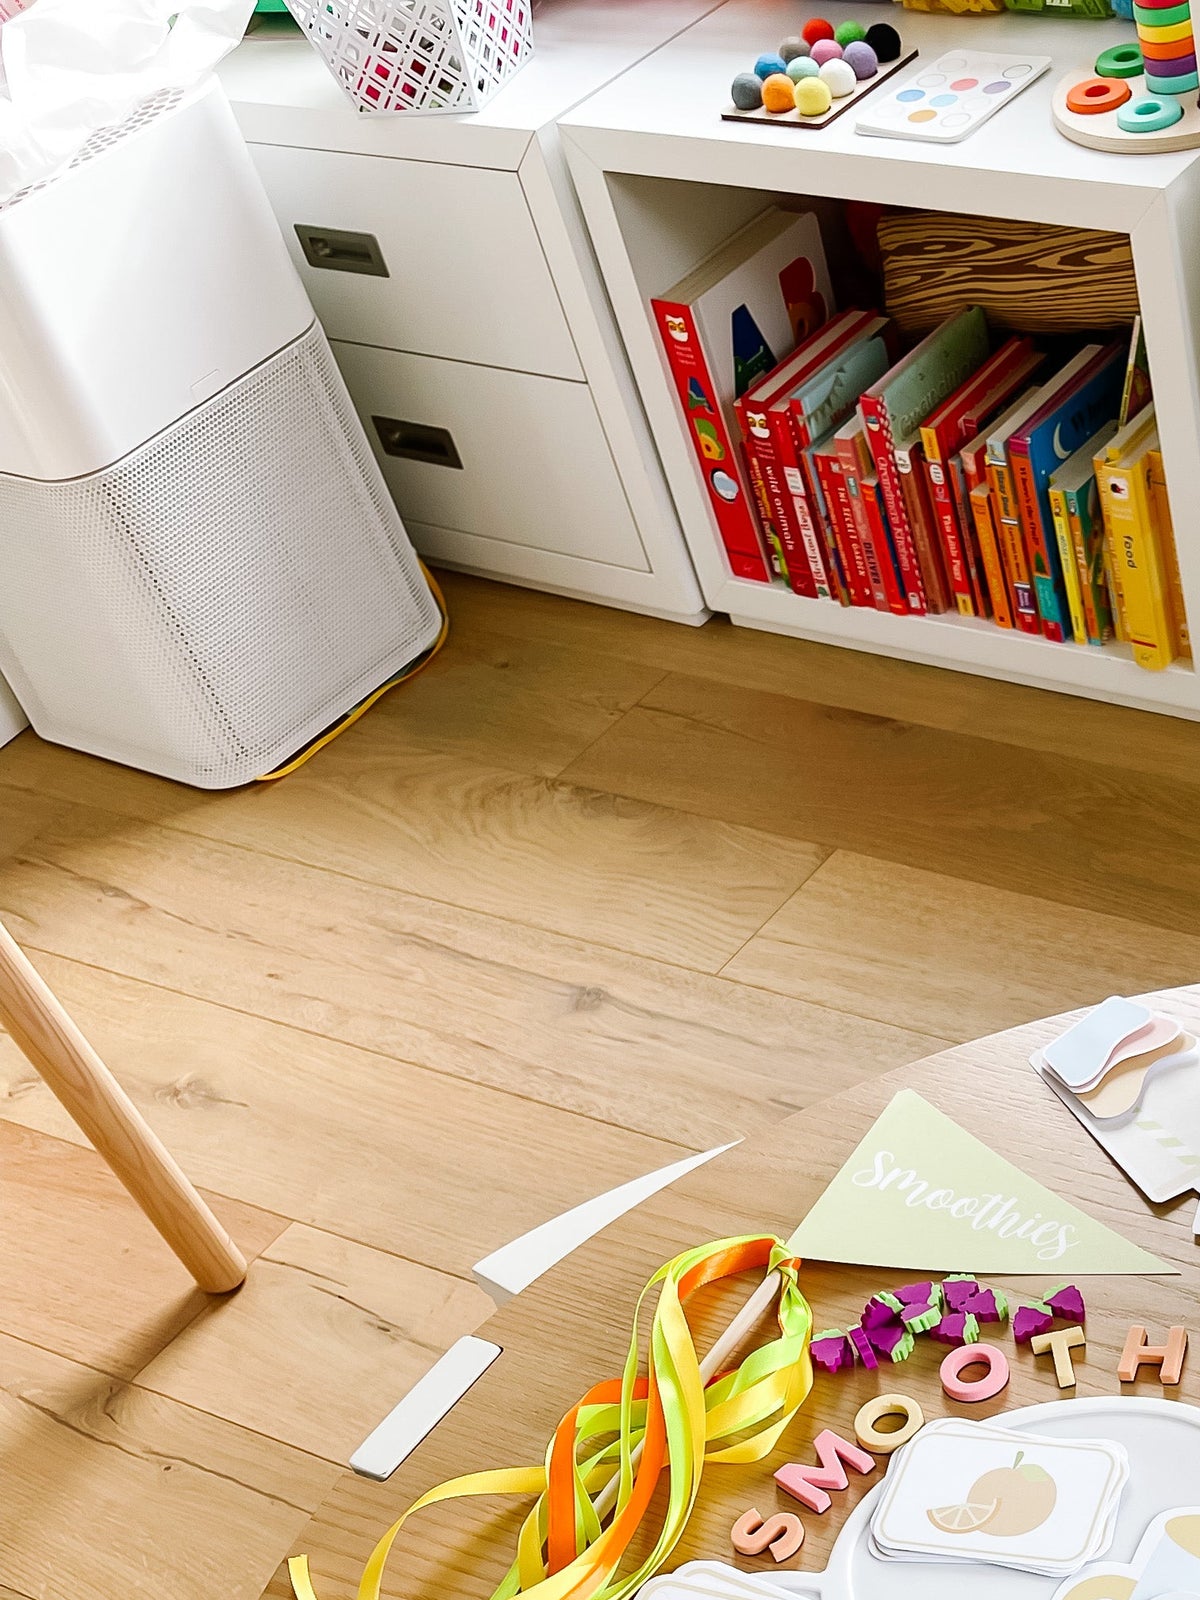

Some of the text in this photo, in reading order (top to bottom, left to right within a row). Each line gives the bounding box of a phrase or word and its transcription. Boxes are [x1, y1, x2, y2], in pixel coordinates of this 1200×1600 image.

[766, 465, 795, 550] wild animals
[838, 486, 848, 503] THE
[843, 506, 858, 540] SECRET
[852, 543, 866, 578] GARDEN
[863, 541, 882, 585] DELIVER
[1122, 534, 1138, 570] food
[852, 1150, 1081, 1260] Smoothies
